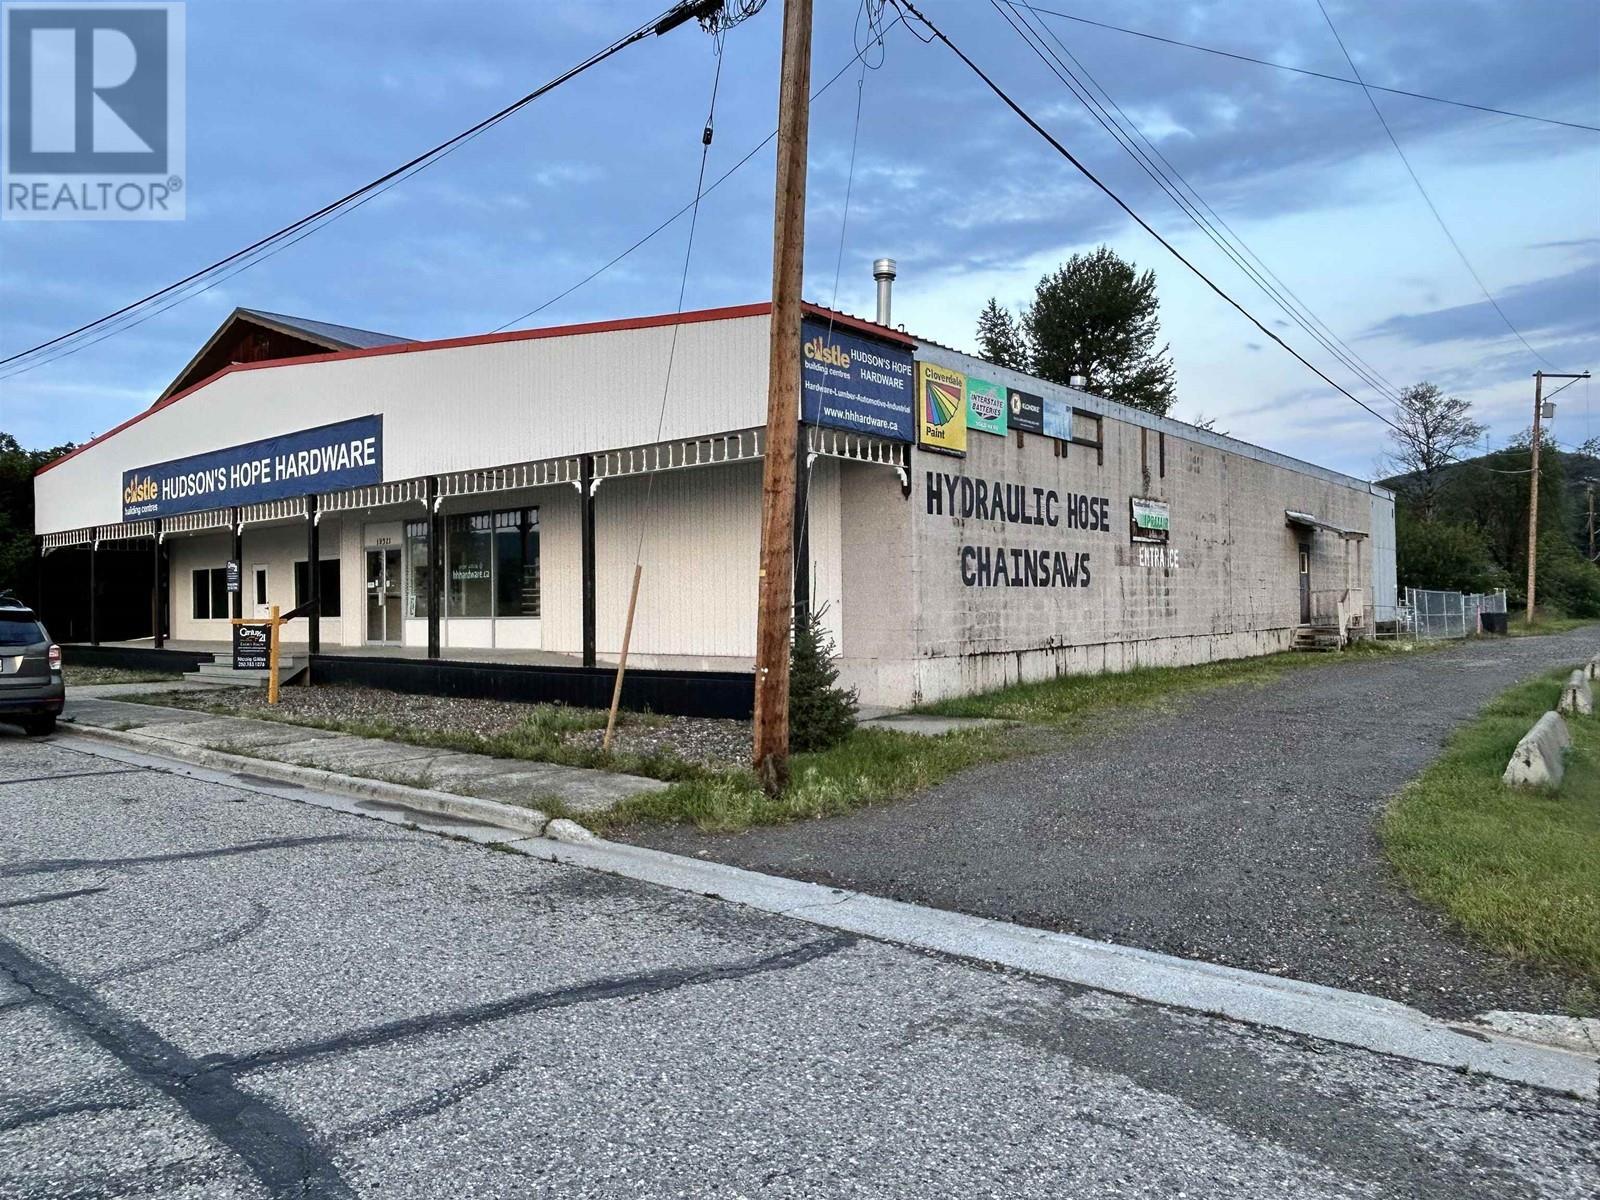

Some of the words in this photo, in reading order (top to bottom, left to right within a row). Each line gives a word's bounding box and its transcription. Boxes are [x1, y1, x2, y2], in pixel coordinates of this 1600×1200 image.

[804, 360, 828, 375] building
[829, 368, 851, 380] centres
[850, 348, 891, 370] HUDSON'S
[891, 361, 912, 376] HOPE
[860, 368, 904, 390] HARDWARE
[925, 367, 963, 388] Cloverdale
[971, 393, 1004, 409] INTERSTATE
[971, 402, 1001, 416] BATTERIES
[823, 406, 899, 431] www.hhhardware.ca
[926, 426, 945, 439] Paint
[162, 468, 227, 501] HUDSON'S
[230, 458, 271, 489] HOPE
[275, 437, 376, 481] HARDWARE
[926, 471, 1059, 527] HYDRAULIC
[1067, 492, 1110, 532] HOSE
[961, 545, 1091, 588] CHAINSAWS
[258, 633, 267, 642] 21
